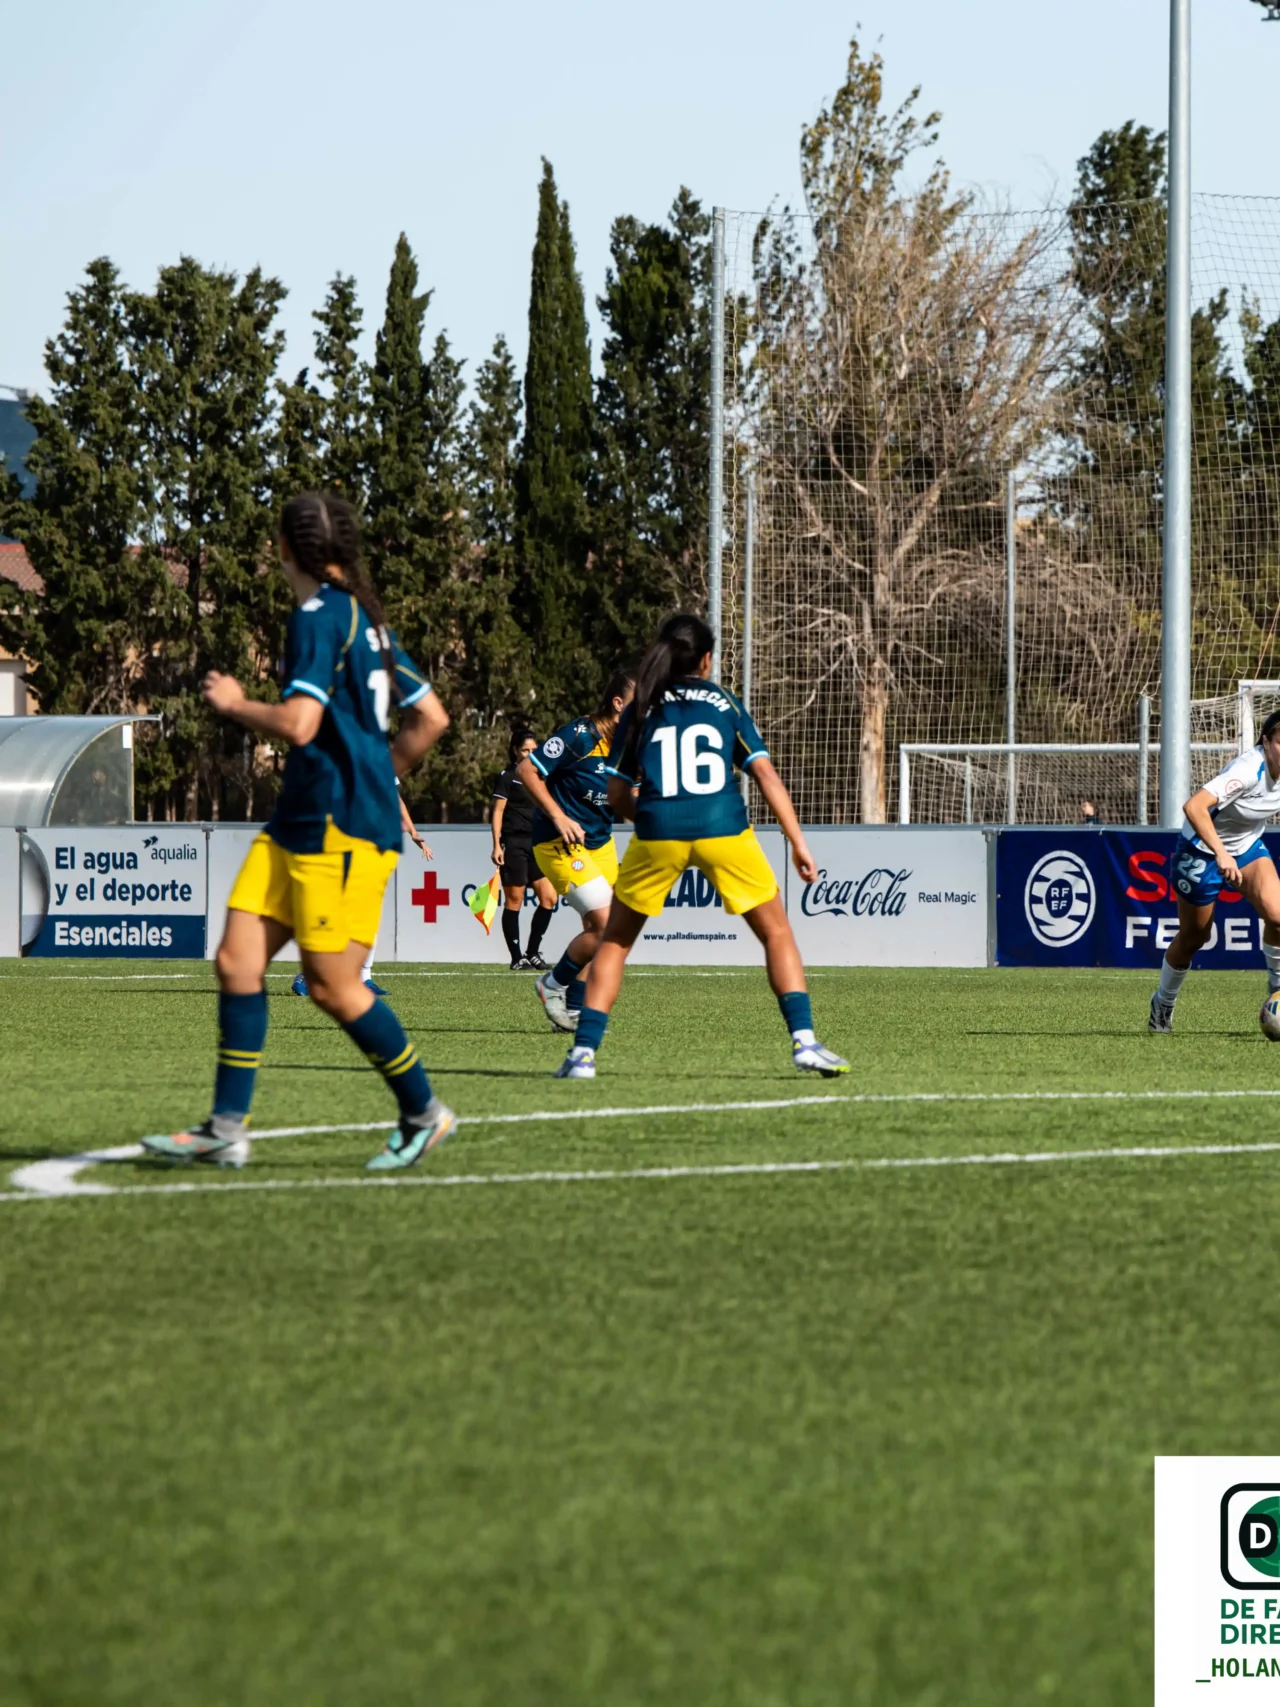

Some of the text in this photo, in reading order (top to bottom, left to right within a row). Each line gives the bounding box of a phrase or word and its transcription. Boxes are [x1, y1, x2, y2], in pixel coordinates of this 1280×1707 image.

[651, 723, 726, 797] 16
[55, 846, 138, 874] El agua
[151, 844, 197, 864] aqualia
[1178, 853, 1207, 883] 22
[55, 877, 192, 906] y el deporte
[918, 891, 977, 905] Real Magic
[55, 920, 172, 947] Esenciales
[643, 932, 737, 942] www.palladiumspain.es
